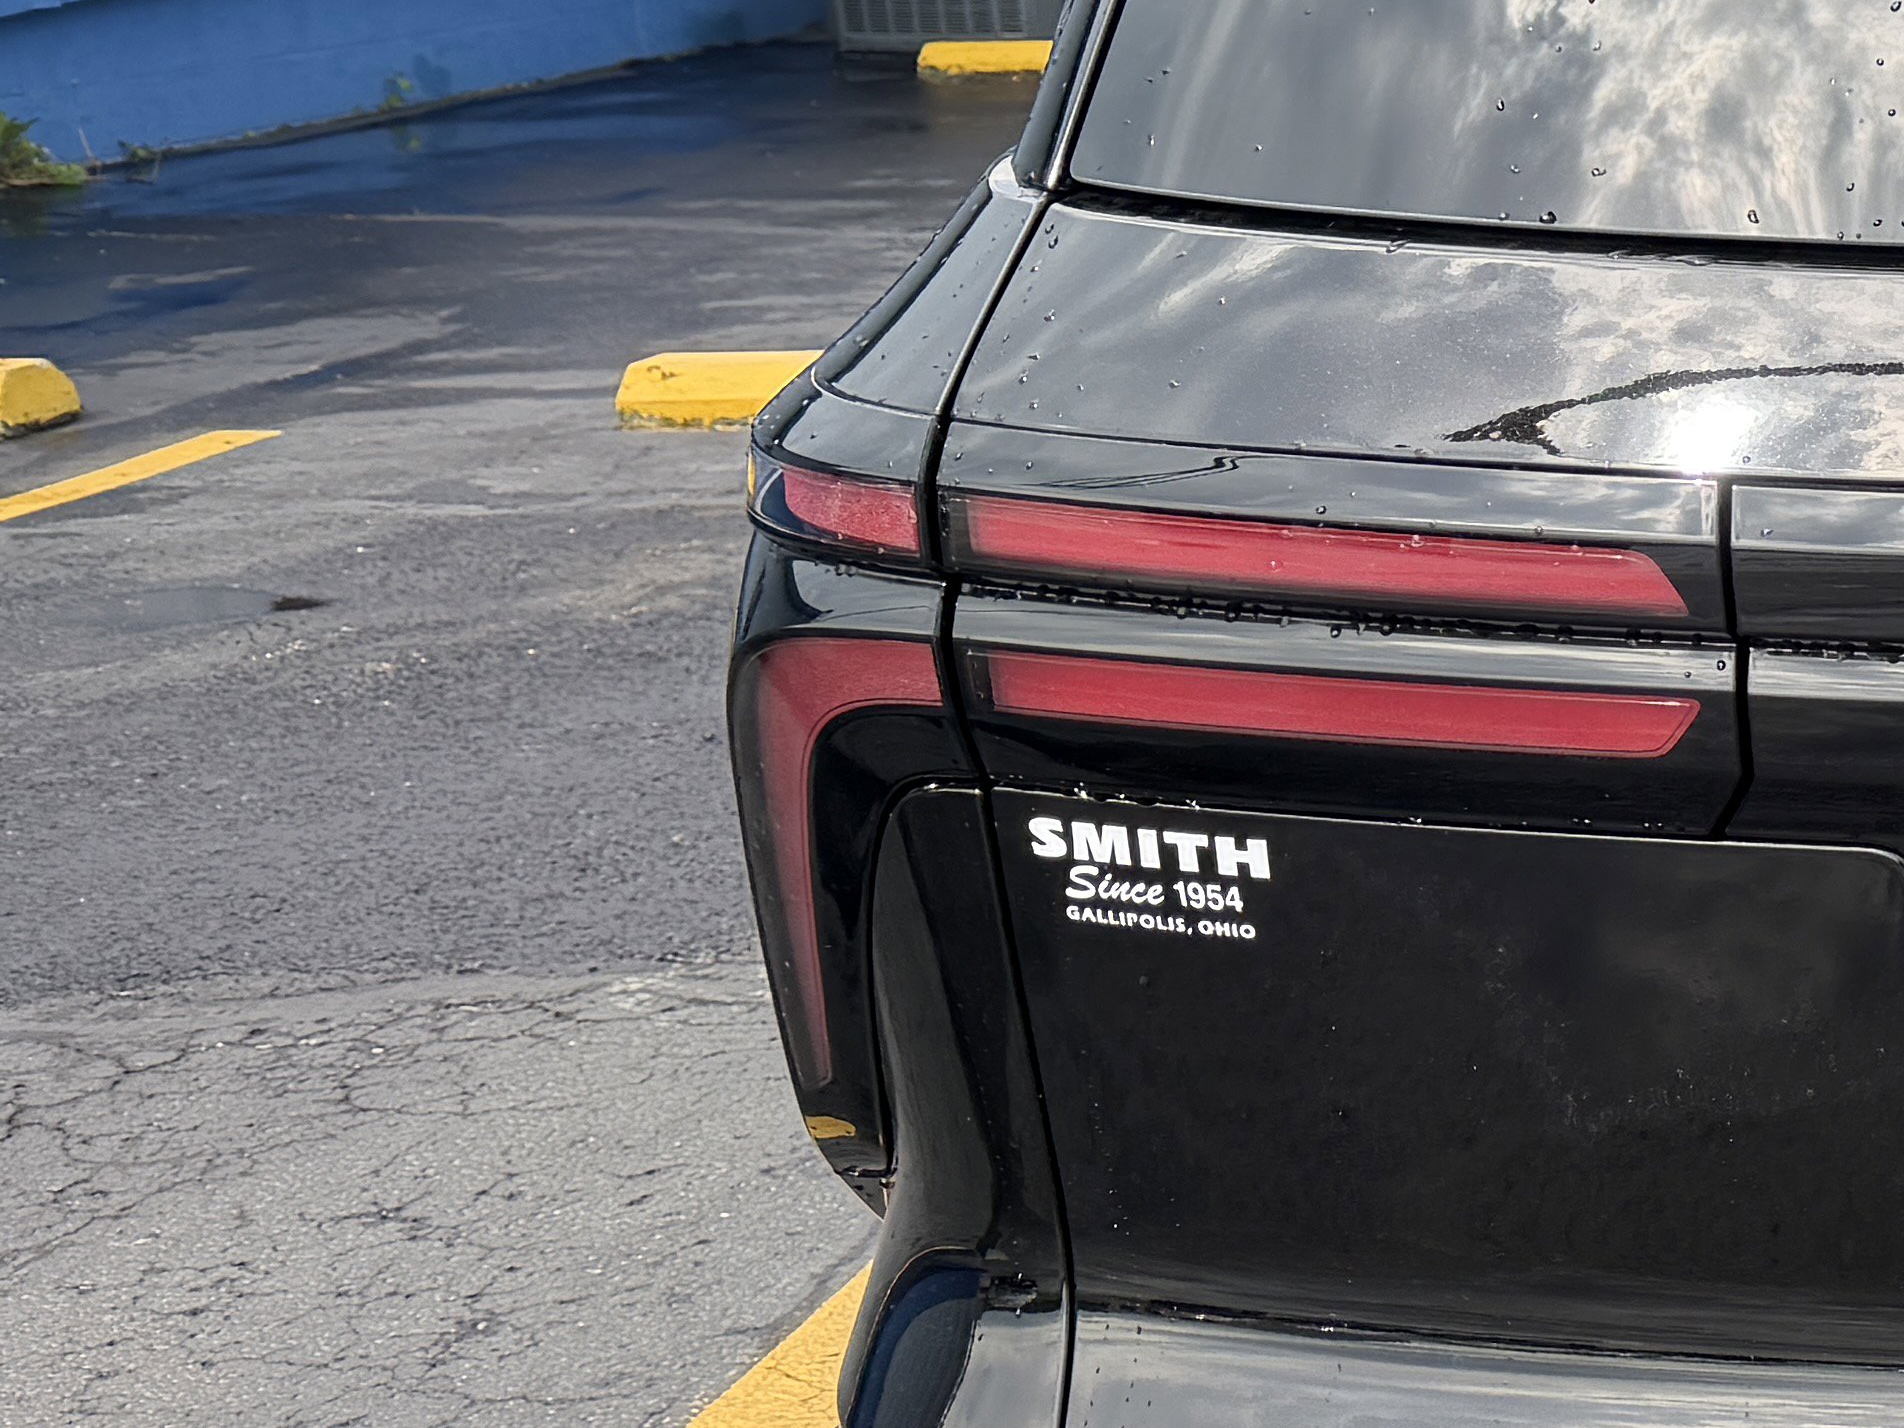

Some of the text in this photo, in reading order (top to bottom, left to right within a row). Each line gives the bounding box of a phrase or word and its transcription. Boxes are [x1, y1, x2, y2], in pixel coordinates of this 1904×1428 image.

[1028, 816, 1271, 880] SMITH
[1065, 864, 1245, 913] Since 1954
[1065, 904, 1257, 940] GALLIPOLIS, OHIO
